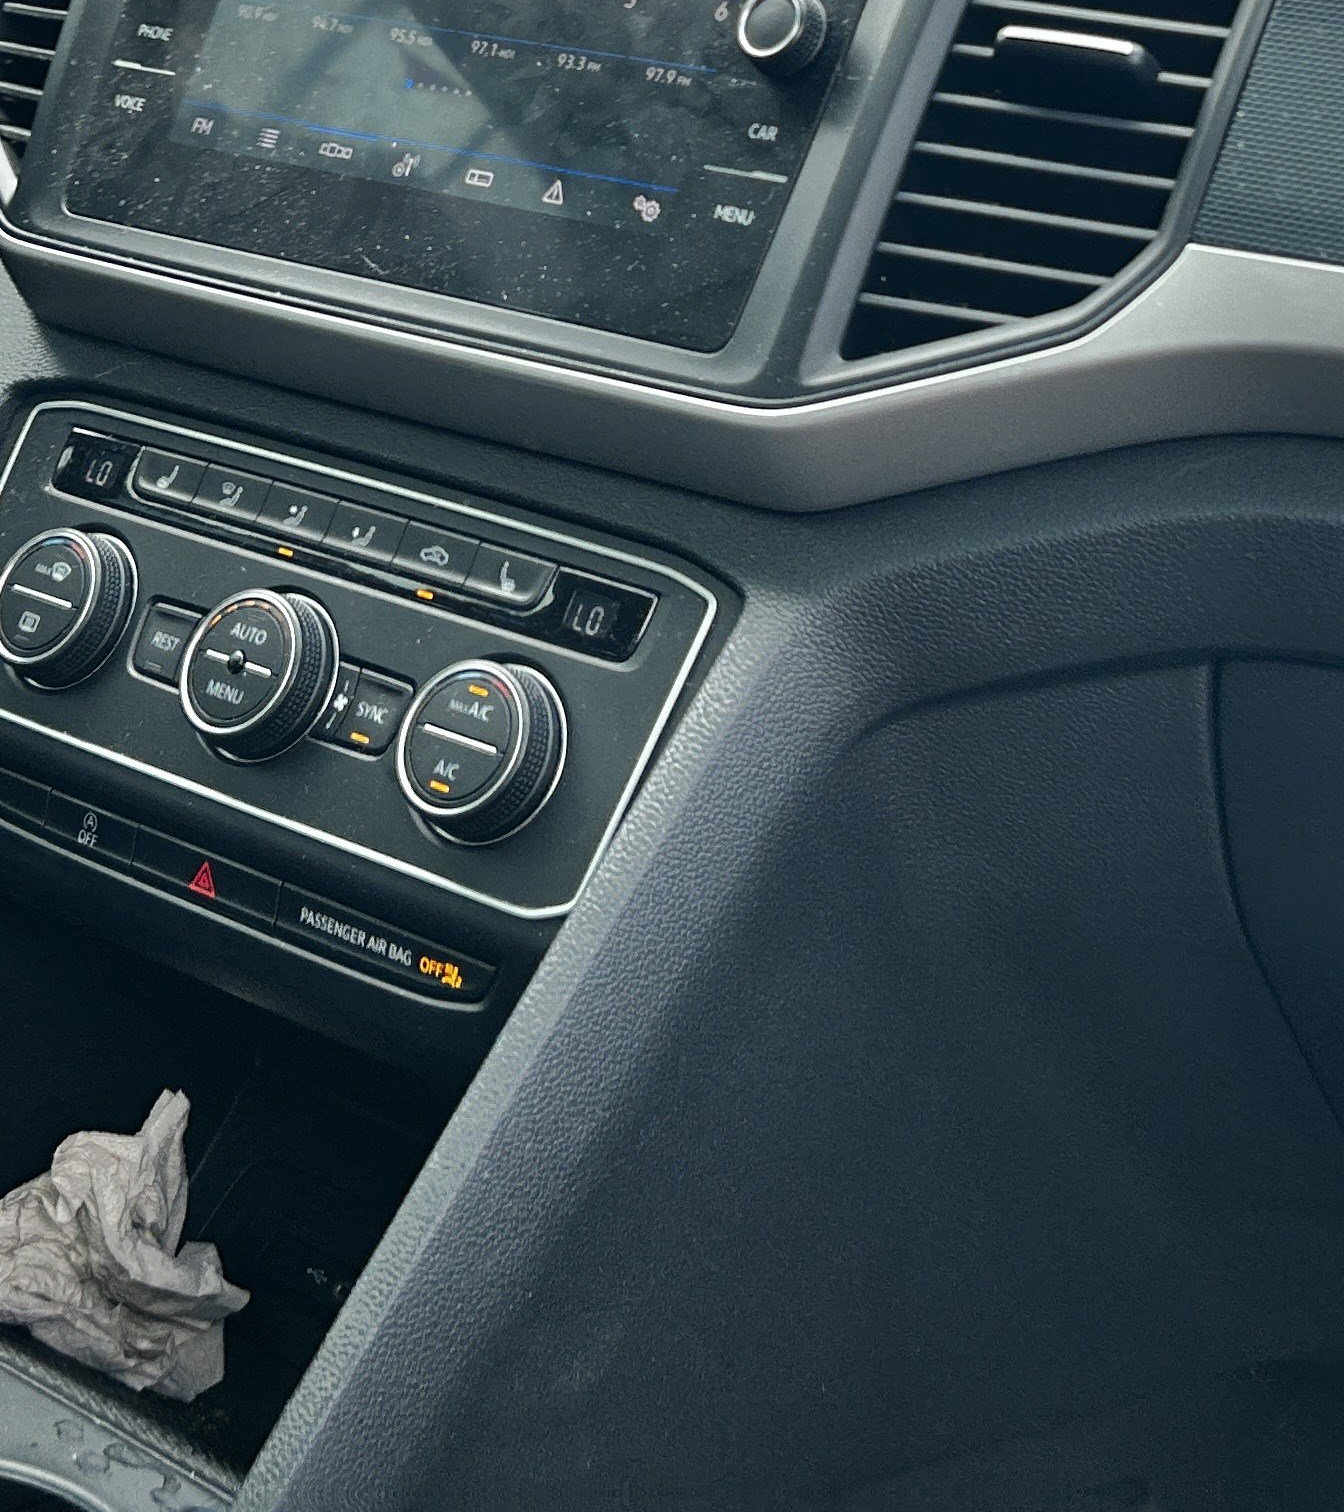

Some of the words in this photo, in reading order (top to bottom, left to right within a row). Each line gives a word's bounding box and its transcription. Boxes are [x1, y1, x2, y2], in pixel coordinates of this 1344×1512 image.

[714, 1, 729, 22] 6
[137, 23, 174, 42] PHONE
[470, 40, 498, 58] 97.1
[557, 53, 587, 71] 93.3
[646, 66, 677, 85] 97.9
[114, 93, 147, 112] VOICE
[191, 116, 214, 136] FM
[747, 123, 779, 142] CAR
[712, 203, 756, 227] MENU
[85, 459, 113, 486] LO
[572, 604, 605, 636] LO
[153, 630, 181, 652] REST
[229, 621, 268, 647] AUTO
[205, 678, 244, 706] MENU
[355, 700, 389, 725] SYNC
[467, 700, 495, 724] A/C
[432, 758, 461, 781] A/C
[77, 829, 98, 848] OFF
[299, 905, 367, 948] PASSENGER
[366, 936, 388, 958] AIR
[388, 943, 413, 967] BAG
[419, 955, 445, 979] OFF
